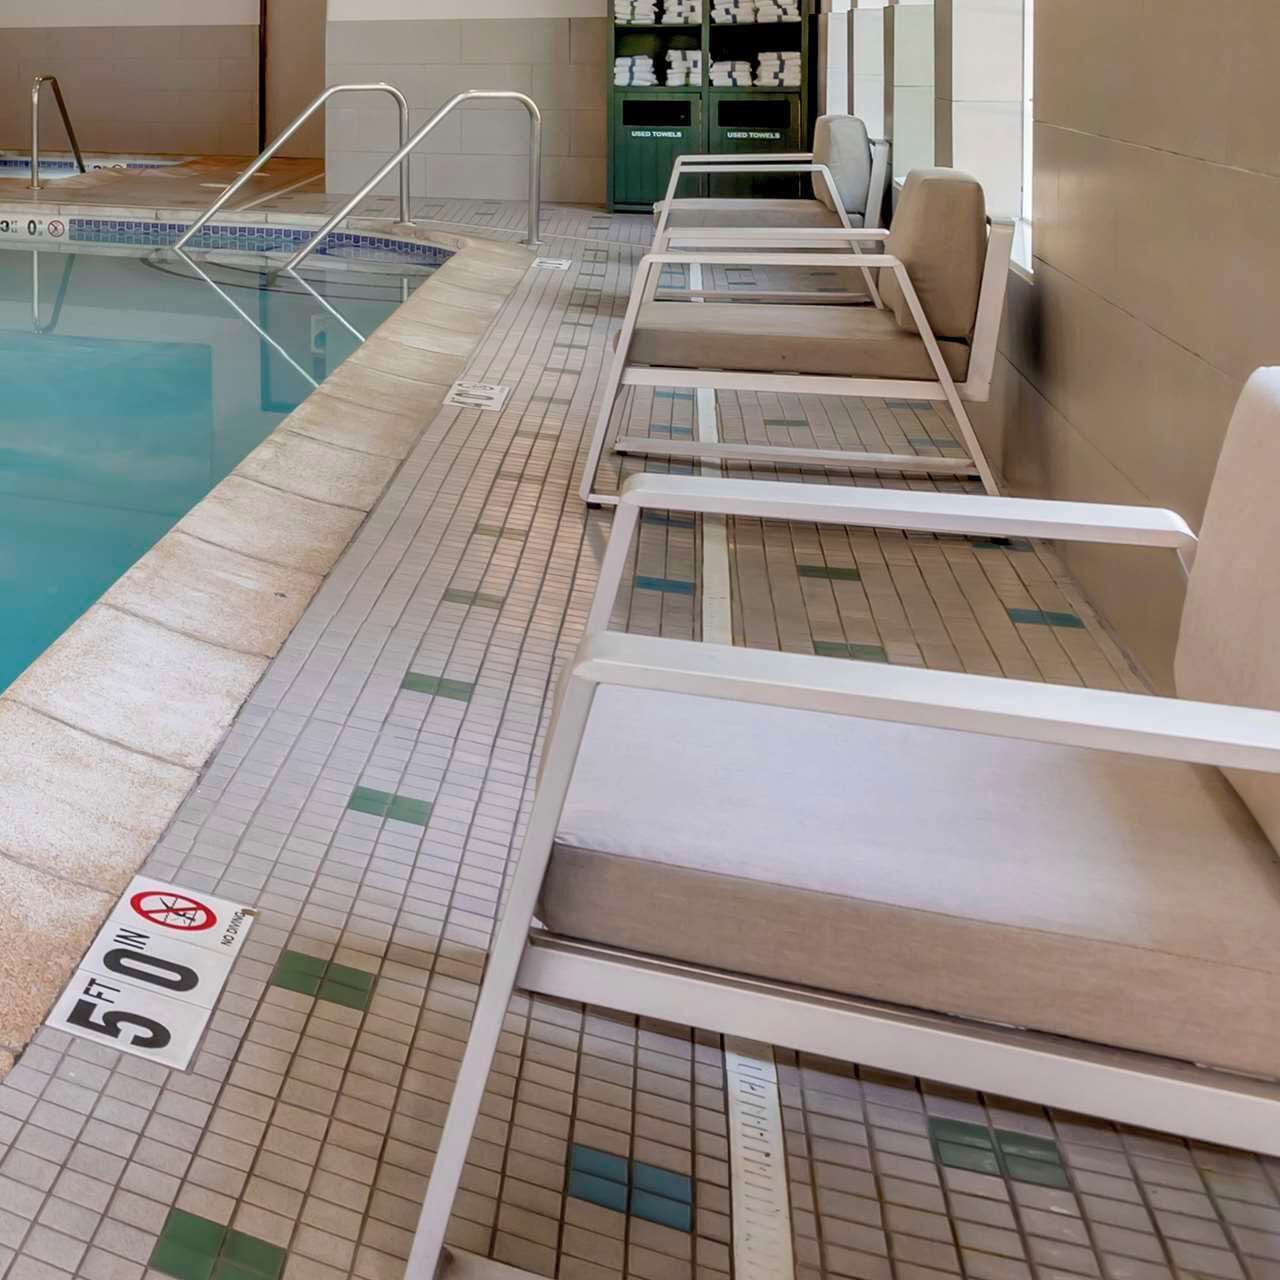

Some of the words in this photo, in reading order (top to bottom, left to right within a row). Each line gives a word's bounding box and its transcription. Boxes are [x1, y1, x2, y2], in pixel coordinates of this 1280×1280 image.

[28, 220, 37, 235] 0
[226, 911, 246, 935] DIVING
[113, 928, 150, 950] IN
[220, 934, 234, 947] NO
[103, 948, 199, 992] 0
[83, 978, 121, 1004] FT
[67, 998, 171, 1049] 5
